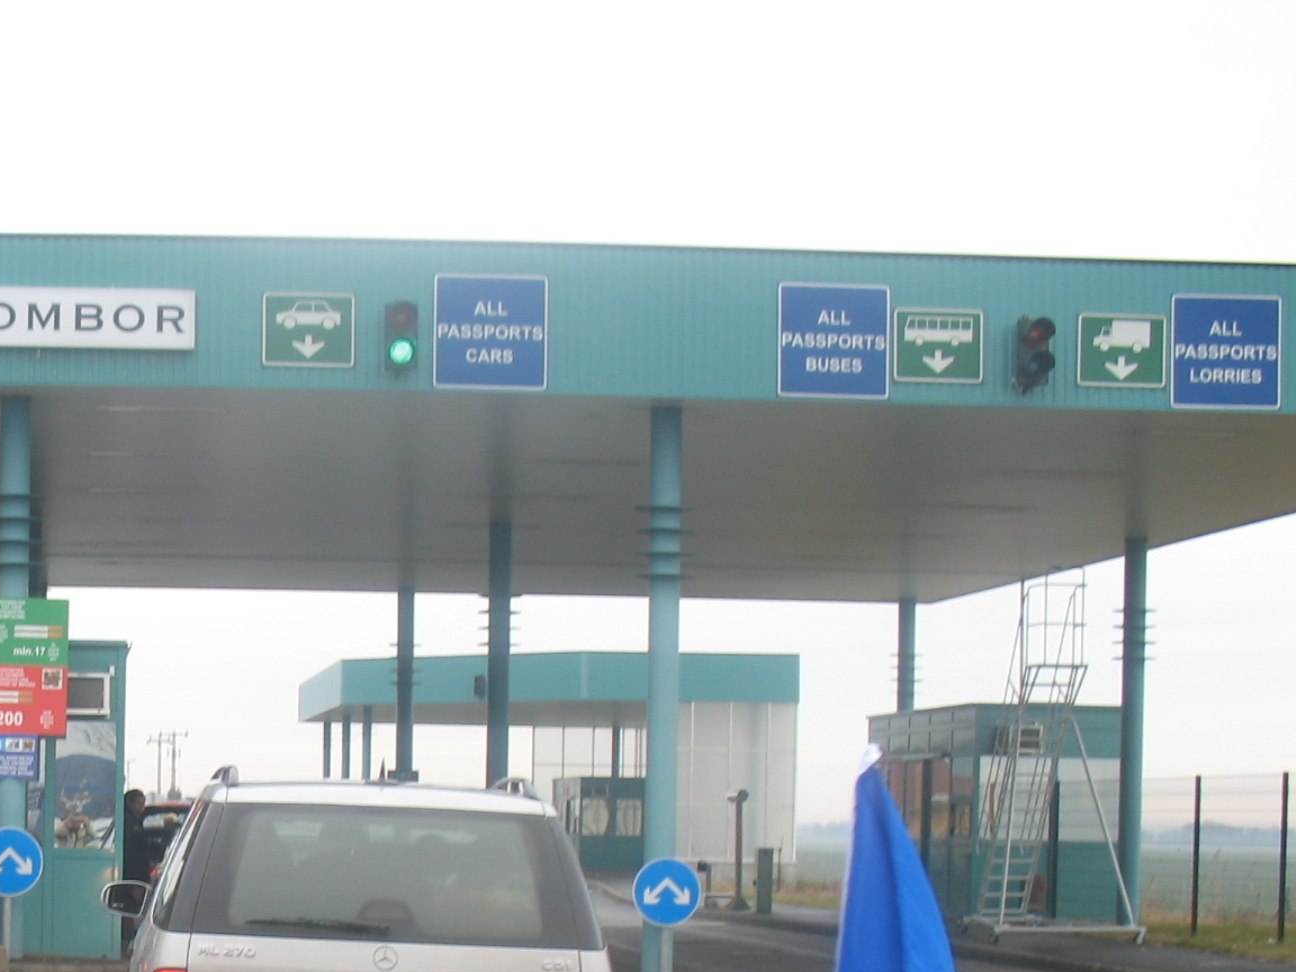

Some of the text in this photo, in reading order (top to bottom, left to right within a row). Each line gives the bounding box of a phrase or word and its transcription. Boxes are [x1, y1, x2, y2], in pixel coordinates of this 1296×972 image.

[473, 300, 508, 317] ALL
[817, 309, 852, 326] ALL
[437, 323, 544, 342] PASSPORTS
[1209, 320, 1243, 337] ALL
[782, 331, 886, 351] PASSPORTS
[466, 347, 514, 364] CARS
[1175, 343, 1277, 361] PASSPORTS
[806, 356, 863, 373] BUSES
[1189, 367, 1262, 385] LORRIES
[223, 944, 257, 959] 270
